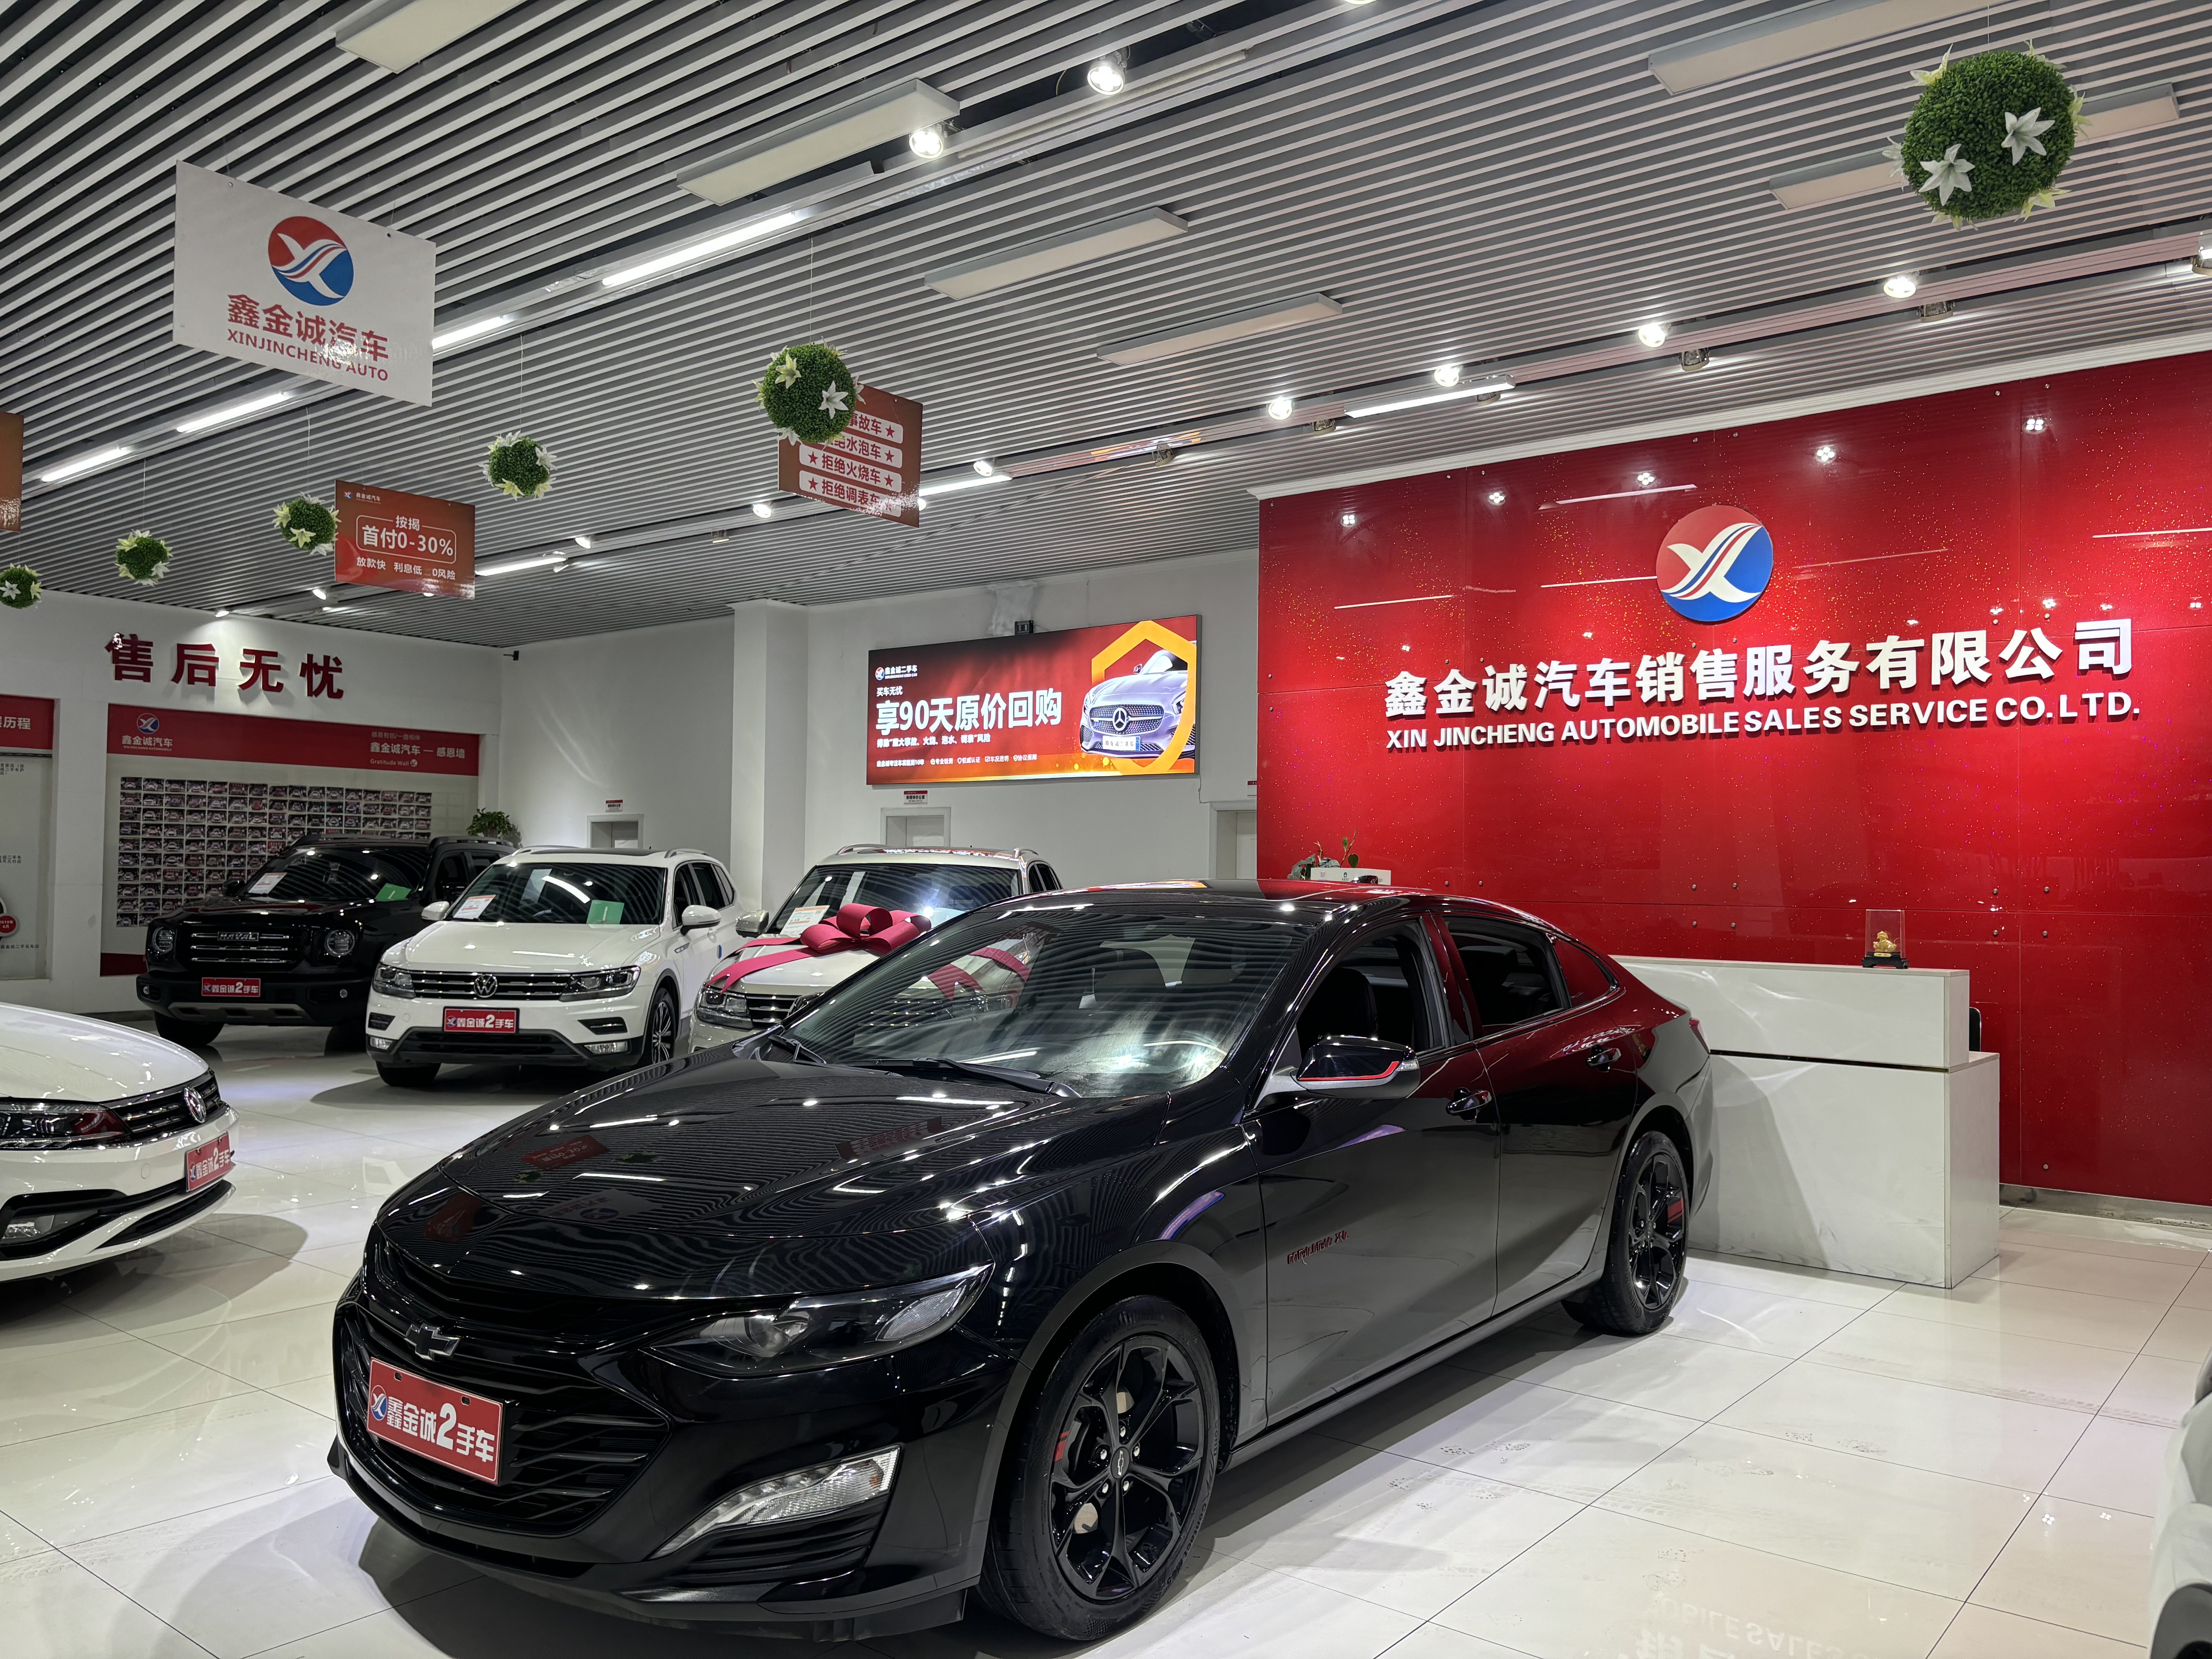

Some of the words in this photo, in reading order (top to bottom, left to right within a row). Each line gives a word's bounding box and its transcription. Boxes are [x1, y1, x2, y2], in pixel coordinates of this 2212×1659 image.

[228, 294, 389, 362] 鑫金诚汽车
[227, 328, 342, 370] XINJINCHENG
[346, 361, 389, 381] AUTO
[822, 453, 881, 484] 拒绝火烧车
[395, 515, 420, 531] 按揭
[362, 525, 453, 556] 首付0-30%
[356, 556, 386, 570] 放款快
[393, 562, 422, 575] 利息低
[432, 568, 456, 580] 0风险
[105, 632, 344, 699] 售后无忧
[1385, 618, 2132, 718] 鑫金诚汽车销售服务有限公司
[876, 686, 903, 697] 买车无忧
[0, 716, 31, 730] 历程
[876, 688, 1062, 736] 享90天原价回购
[1386, 728, 1427, 749] XIN
[1434, 721, 1554, 747] JINCHENG
[1561, 711, 1739, 741] AUTOMOBILE
[1744, 706, 1842, 733] SALES
[1849, 698, 1987, 727] SERVICE
[122, 735, 173, 747] 鑫金诚汽车
[370, 742, 421, 755] 鑫金诚汽车
[457, 1014, 515, 1030] 鑫金诚2手车
[386, 1396, 495, 1463] 鑫金诚2手车
